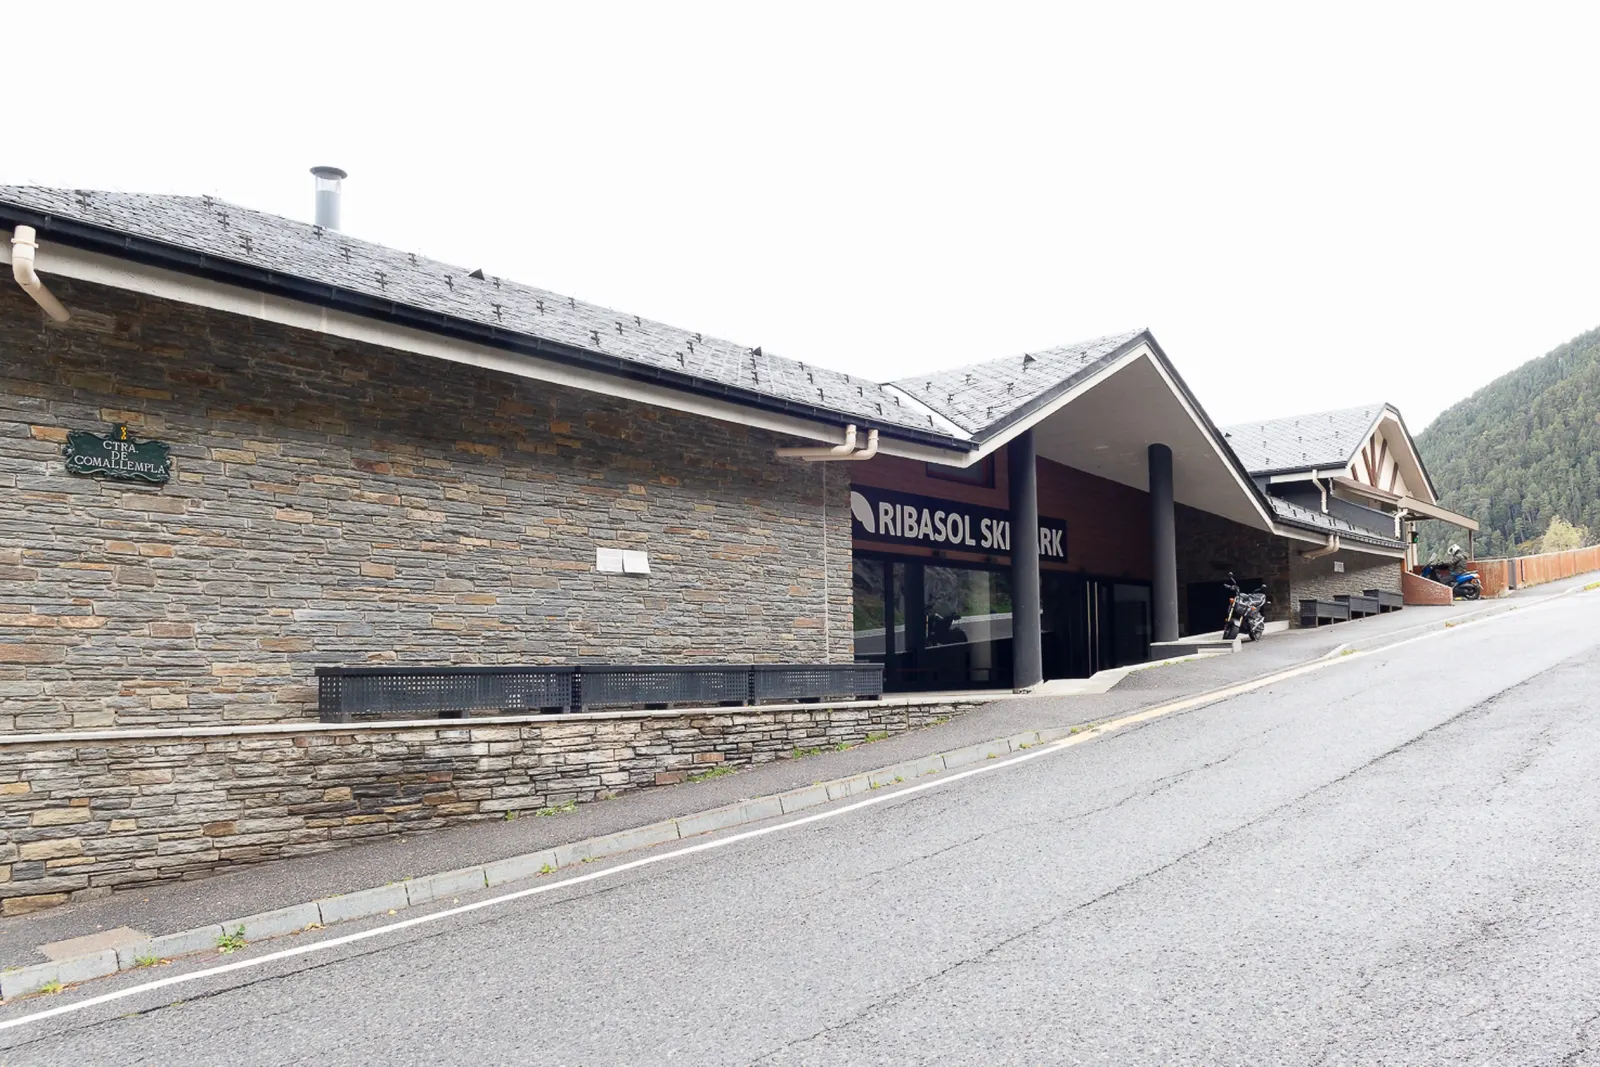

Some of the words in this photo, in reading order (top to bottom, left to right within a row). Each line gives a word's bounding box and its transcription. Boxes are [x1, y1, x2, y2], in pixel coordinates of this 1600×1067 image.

[74, 455, 165, 474] COMALLEMPLA
[111, 451, 128, 461] DE
[879, 502, 976, 546] RIBASOL
[980, 517, 1011, 551] SKI
[1037, 526, 1064, 557] RK
